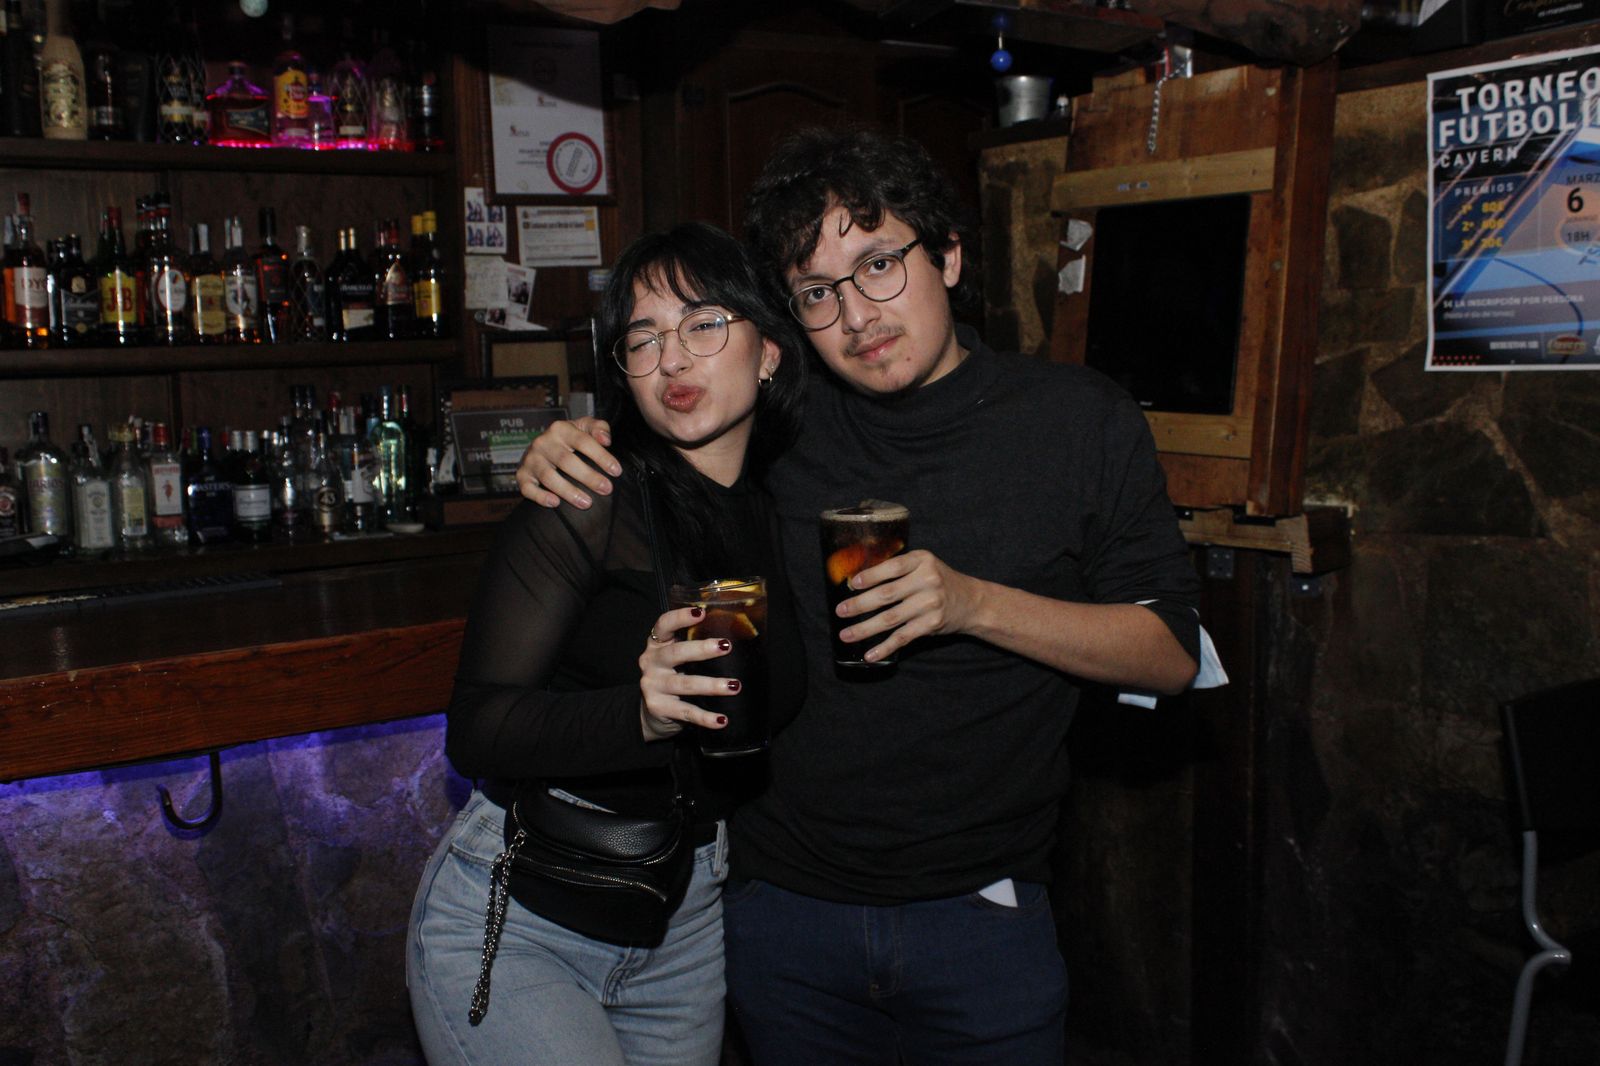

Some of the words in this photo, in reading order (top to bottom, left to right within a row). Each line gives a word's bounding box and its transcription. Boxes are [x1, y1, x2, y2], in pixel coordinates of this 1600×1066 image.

[1455, 66, 1600, 115] TORNEO
[1438, 95, 1600, 148] FUTBOLI
[1440, 146, 1518, 169] CAVERN
[1454, 182, 1514, 197] PREMIOS
[1567, 187, 1584, 213] 6
[1567, 231, 1590, 242] 18H
[1455, 299, 1466, 308] LA
[1467, 295, 1521, 307] INSCRIPCIÓN
[1523, 296, 1541, 305] POR
[1542, 294, 1584, 304] PERSONA
[500, 418, 525, 428] PUB
[320, 492, 336, 505] 43
